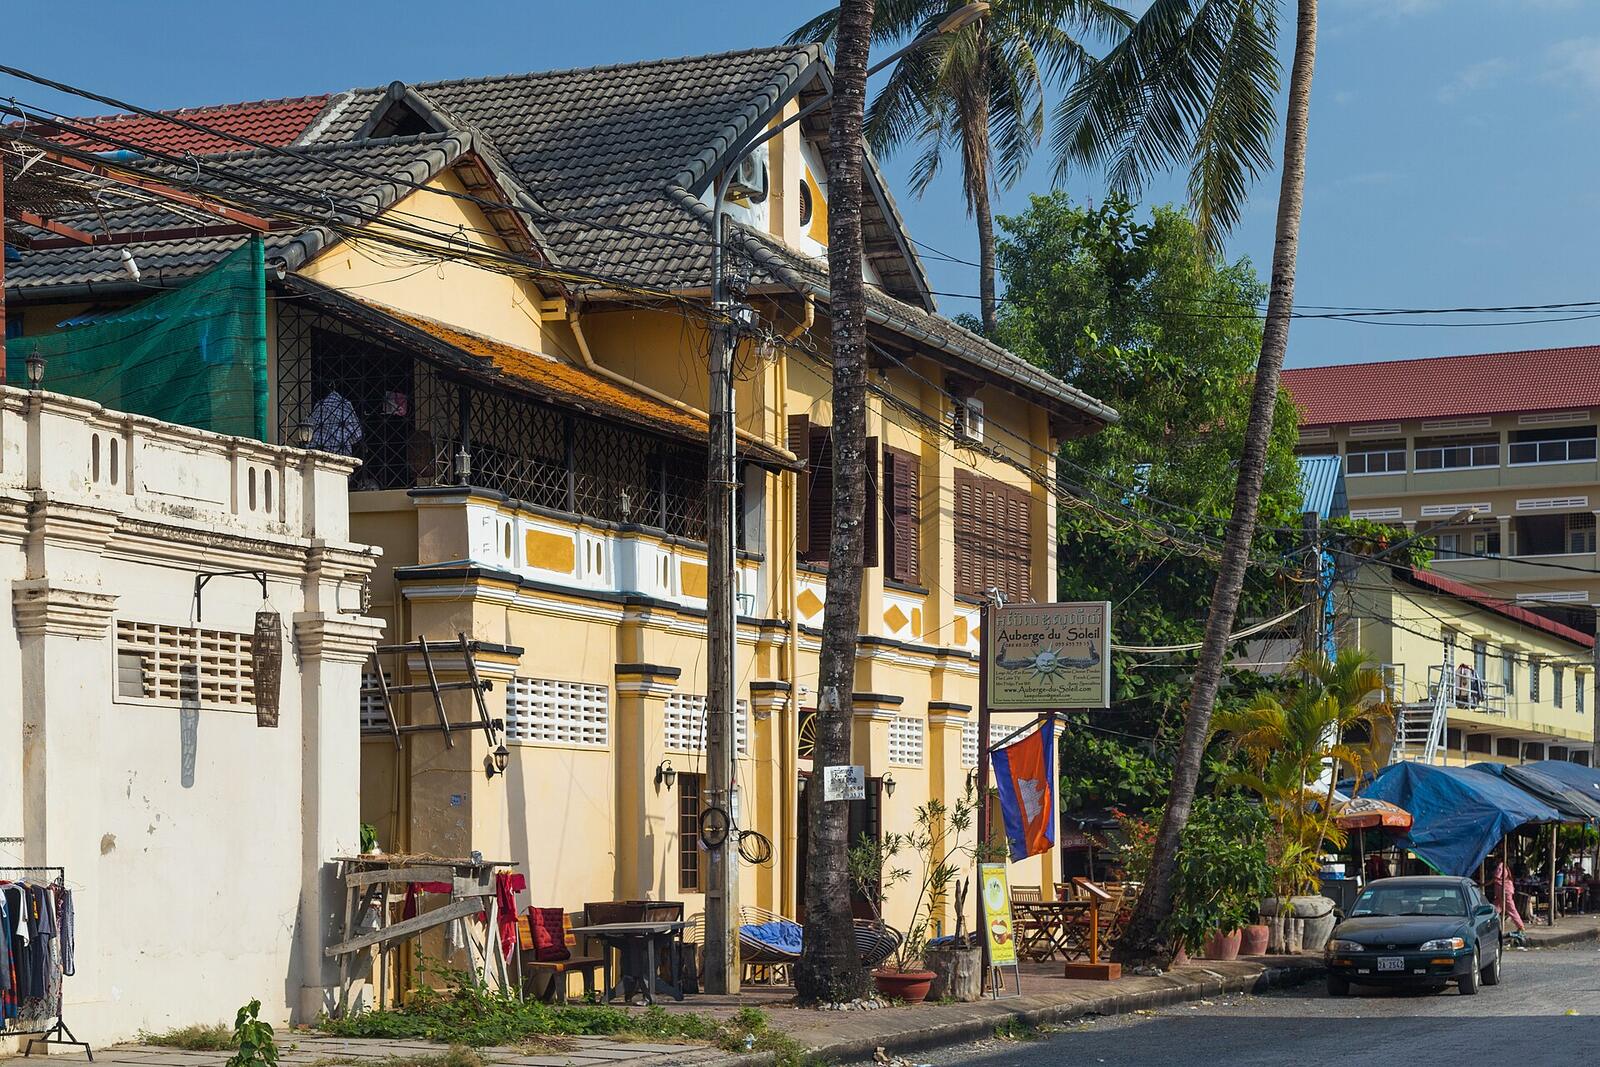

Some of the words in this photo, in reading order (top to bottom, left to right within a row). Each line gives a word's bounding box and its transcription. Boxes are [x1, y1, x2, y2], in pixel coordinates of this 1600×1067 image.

[997, 629, 1045, 643] Auberge
[1048, 628, 1060, 640] du
[1066, 627, 1100, 641] Soleil
